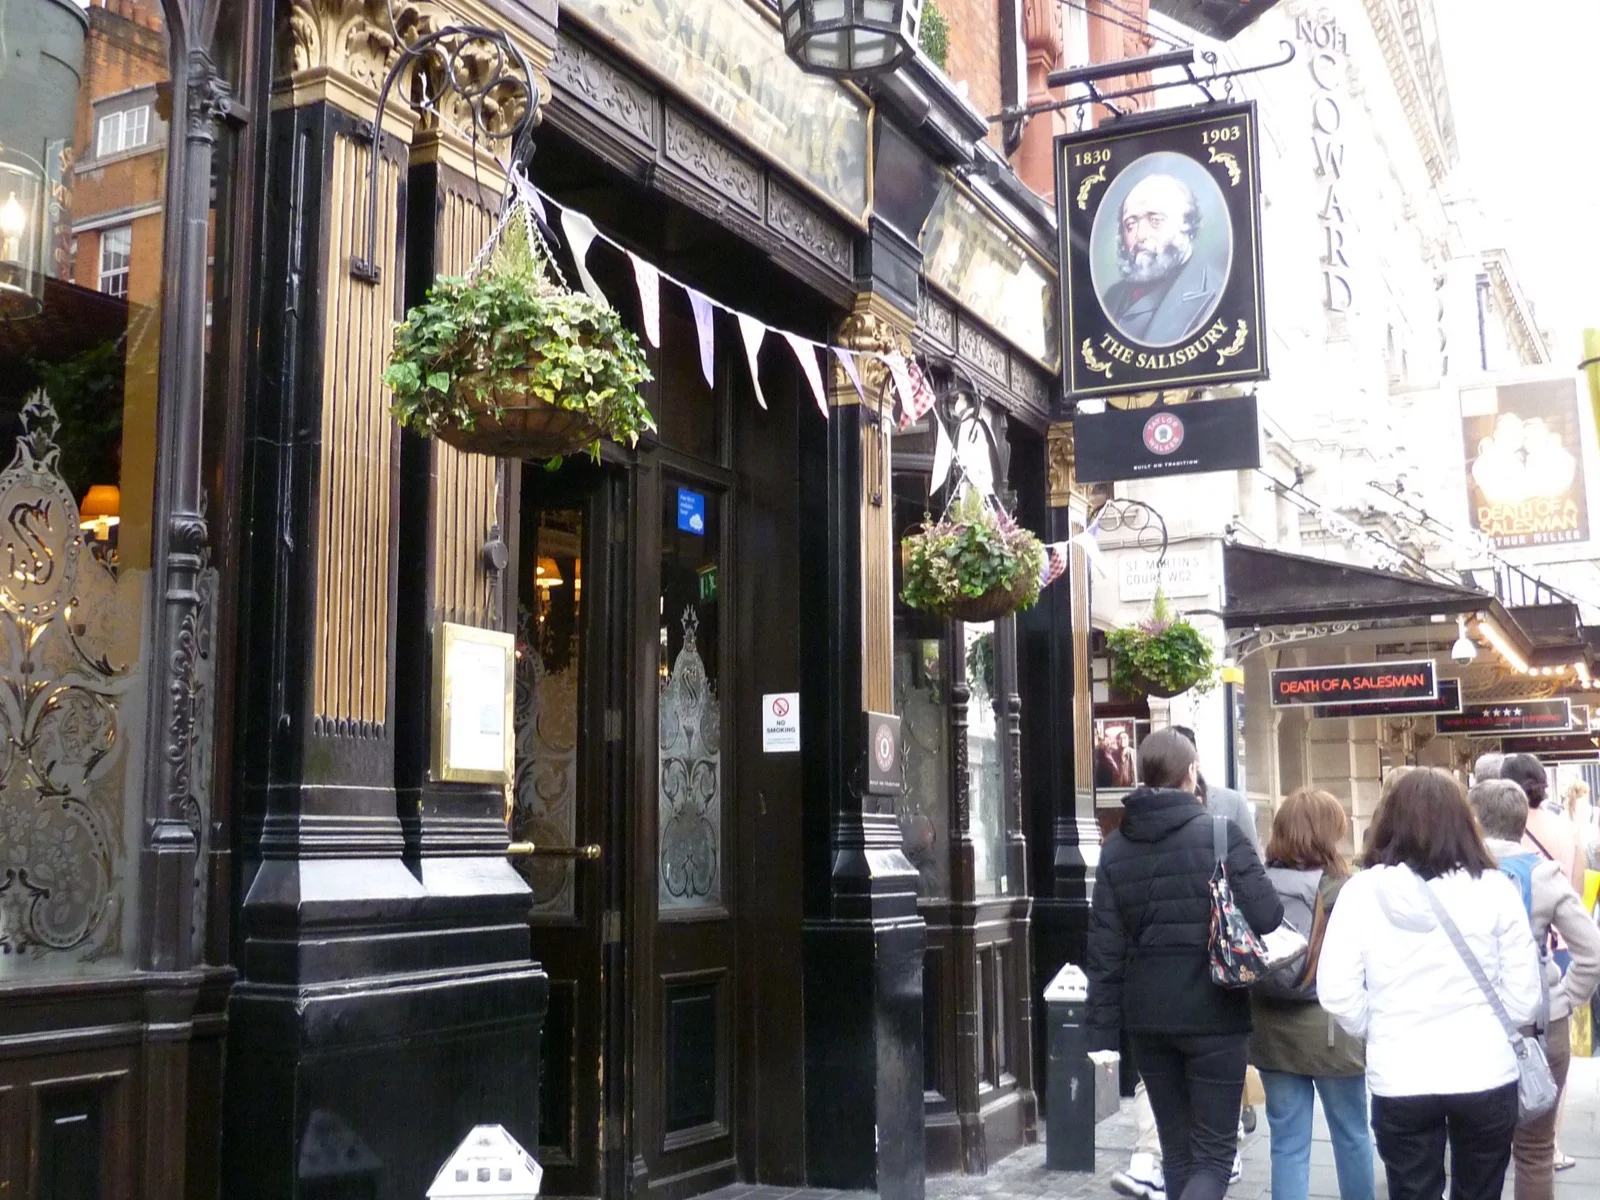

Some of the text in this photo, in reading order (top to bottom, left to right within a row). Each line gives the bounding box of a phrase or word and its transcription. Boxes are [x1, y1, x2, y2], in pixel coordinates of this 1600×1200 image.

[1201, 125, 1240, 145] 1903
[1074, 148, 1111, 167] 1830
[1308, 54, 1352, 313] COWARD
[1099, 317, 1229, 369] THE SALISBURY
[1147, 416, 1180, 430] TAYLOR
[1148, 436, 1180, 452] WALKER
[1477, 497, 1578, 522] DEATH OF A
[1479, 513, 1578, 537] SALESMAN
[1280, 673, 1424, 694] DEATH OF A SALESMAN
[766, 726, 796, 734] SMOKING
